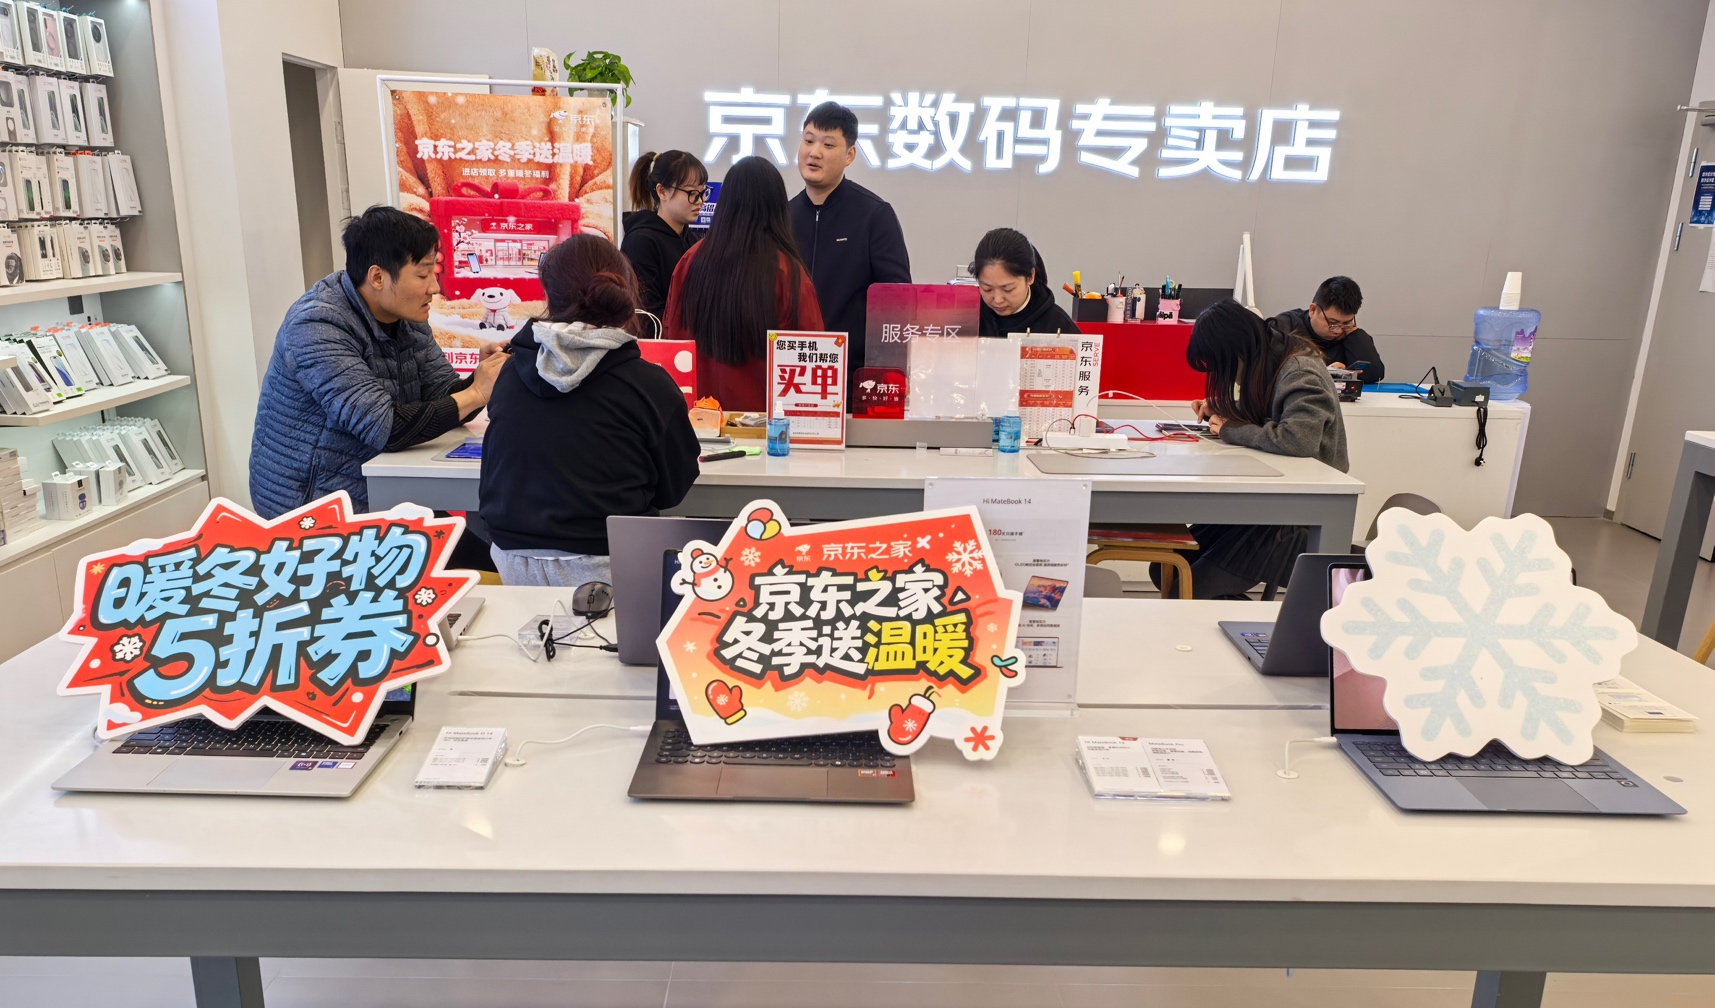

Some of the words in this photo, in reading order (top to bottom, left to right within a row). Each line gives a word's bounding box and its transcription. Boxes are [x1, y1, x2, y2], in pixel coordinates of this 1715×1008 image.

[415, 138, 594, 166] 京东之家冬季送温暖
[499, 222, 534, 231] 京东之家
[776, 339, 818, 351] 您买手机
[881, 323, 962, 343] 服务专区
[797, 352, 839, 363] 我们帮您
[1092, 342, 1101, 367] SERVE
[1077, 341, 1093, 396] 京东服务
[776, 364, 839, 400] 买单
[876, 383, 900, 394] 京东
[821, 540, 912, 561] 京东之家
[97, 525, 428, 625] 暖冬好物
[752, 565, 945, 620] 京东之家
[133, 590, 415, 702] 5折券
[720, 613, 976, 680] 冬季送温暖
